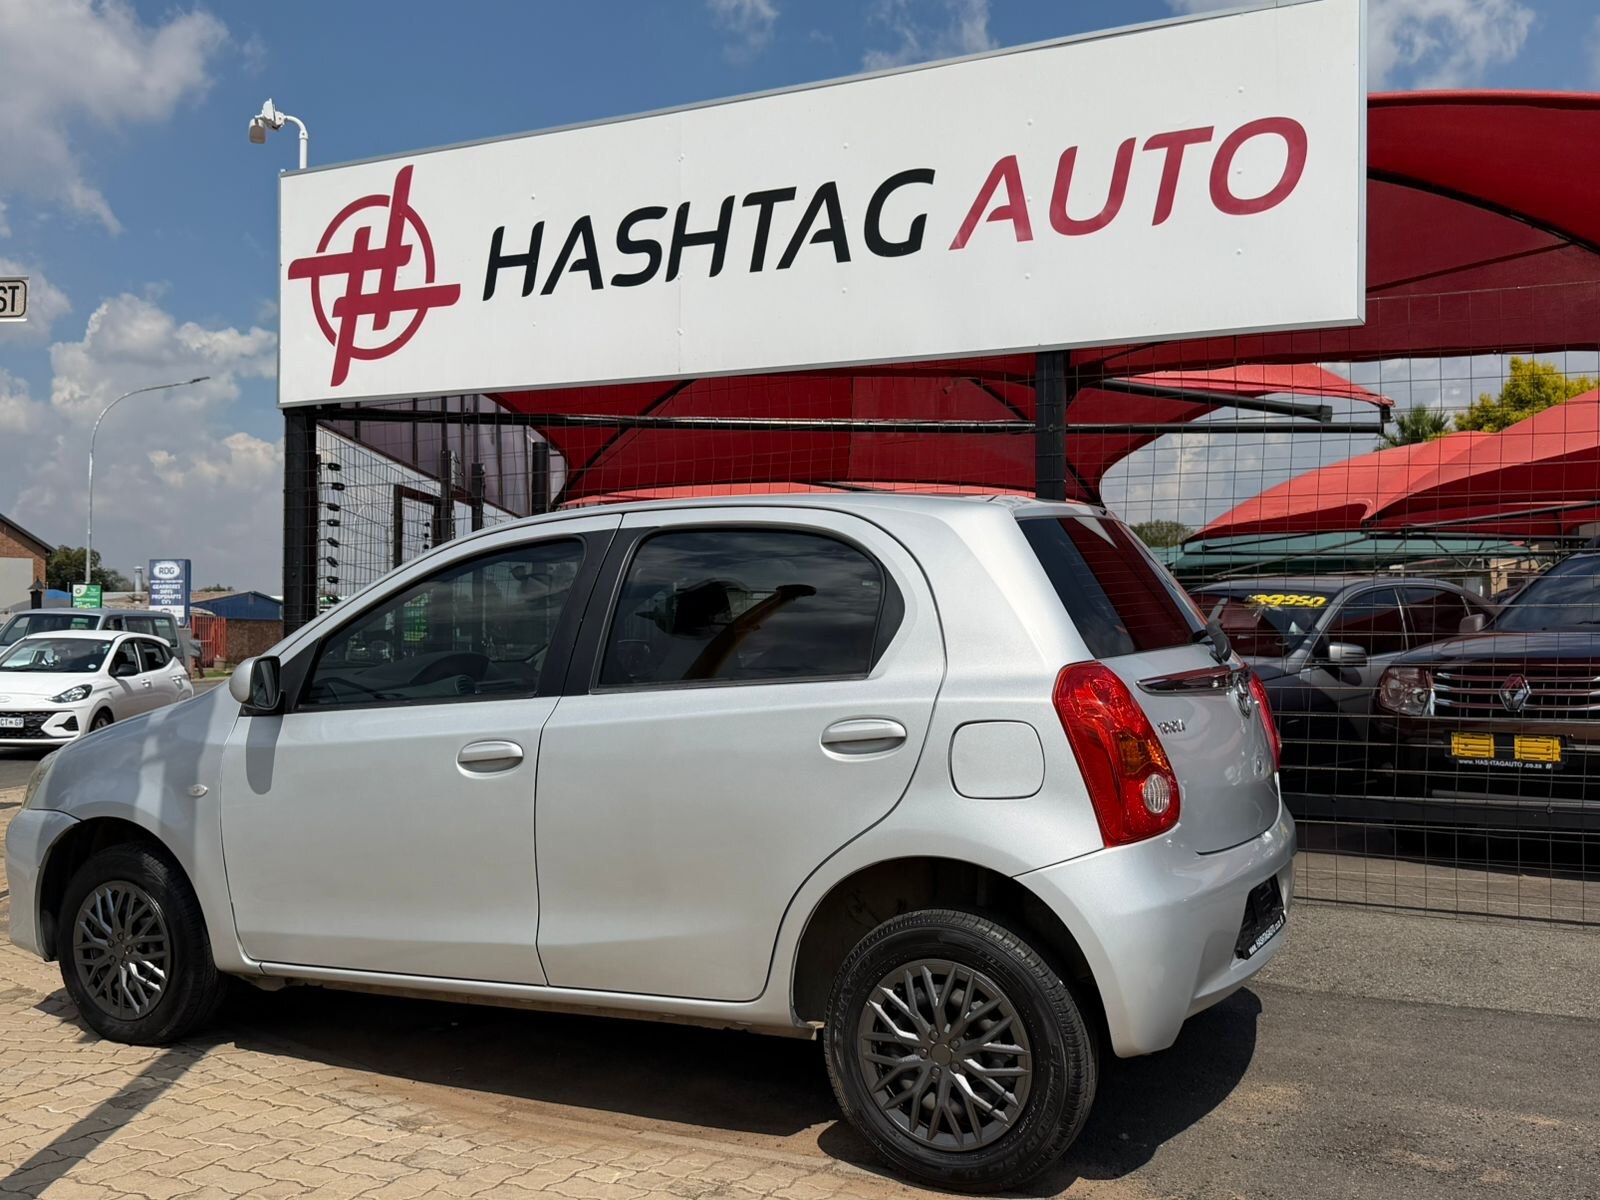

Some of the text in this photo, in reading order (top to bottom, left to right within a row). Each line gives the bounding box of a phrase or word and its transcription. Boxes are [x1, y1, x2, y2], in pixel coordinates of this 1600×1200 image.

[483, 116, 1308, 302] HASHTAG AUTO
[158, 566, 175, 575] RDG
